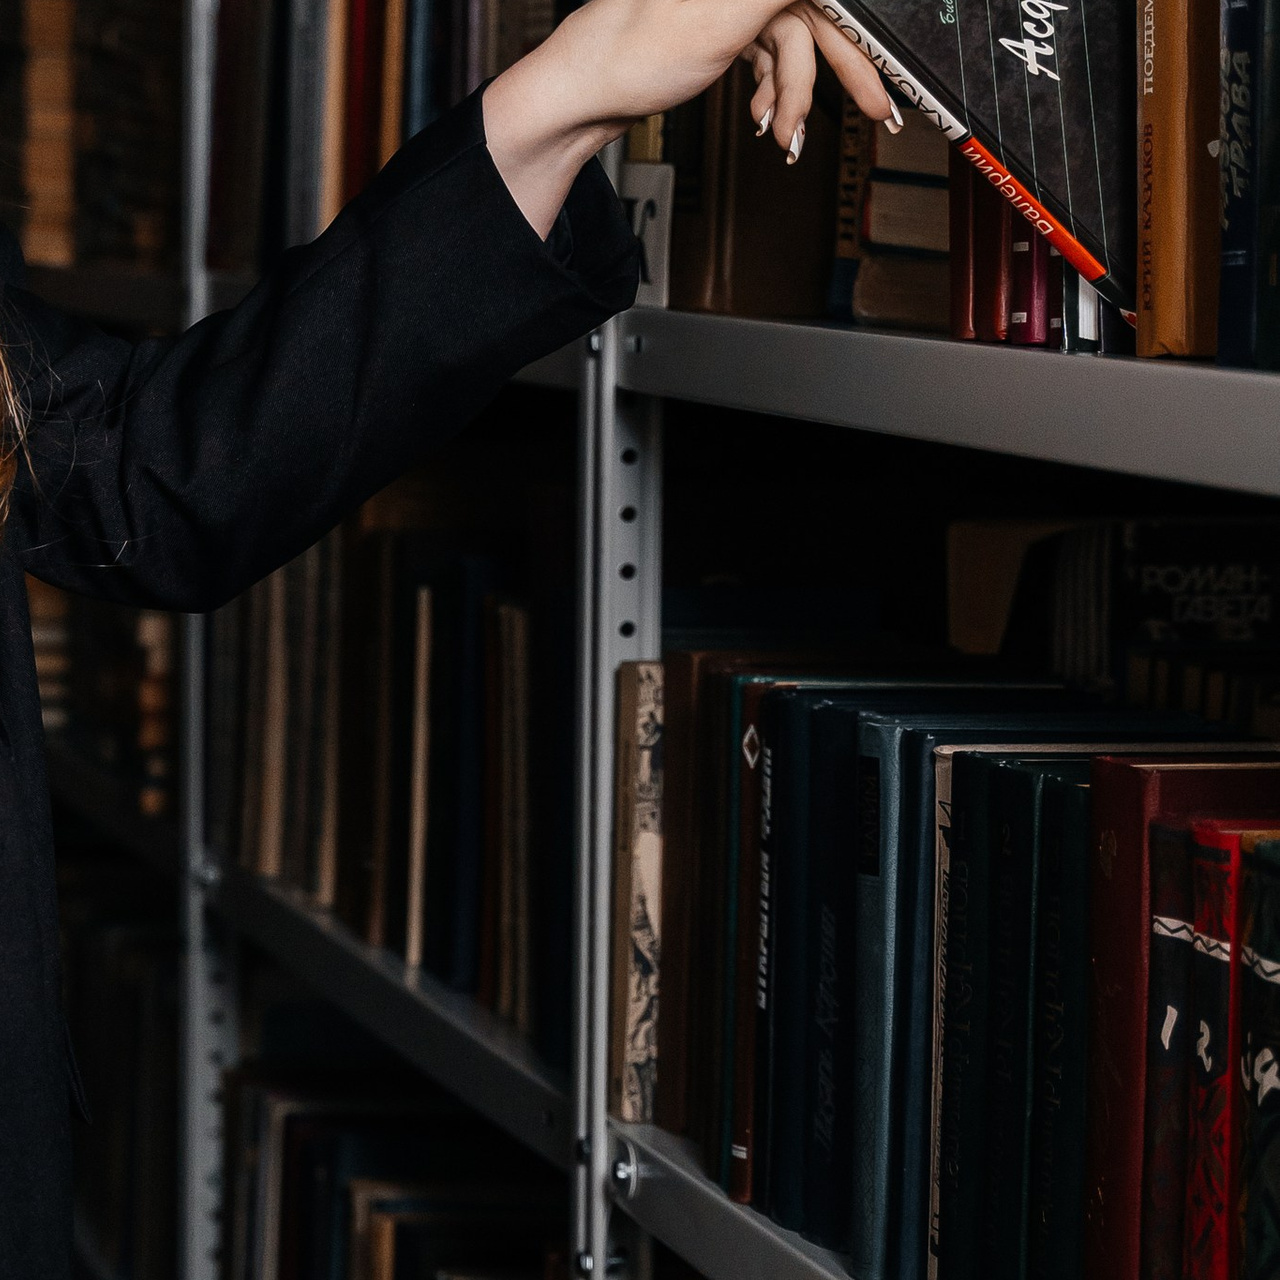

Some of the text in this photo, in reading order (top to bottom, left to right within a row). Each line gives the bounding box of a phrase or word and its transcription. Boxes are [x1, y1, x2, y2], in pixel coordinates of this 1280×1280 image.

[822, 4, 953, 133] КАЗАКОВ
[1229, 50, 1252, 198] ТРАВА
[1142, 122, 1154, 311] ЮРИЙ КАЗАКОВ
[1160, 1004, 1179, 1051] 1
[1196, 1020, 1212, 1072] 2
